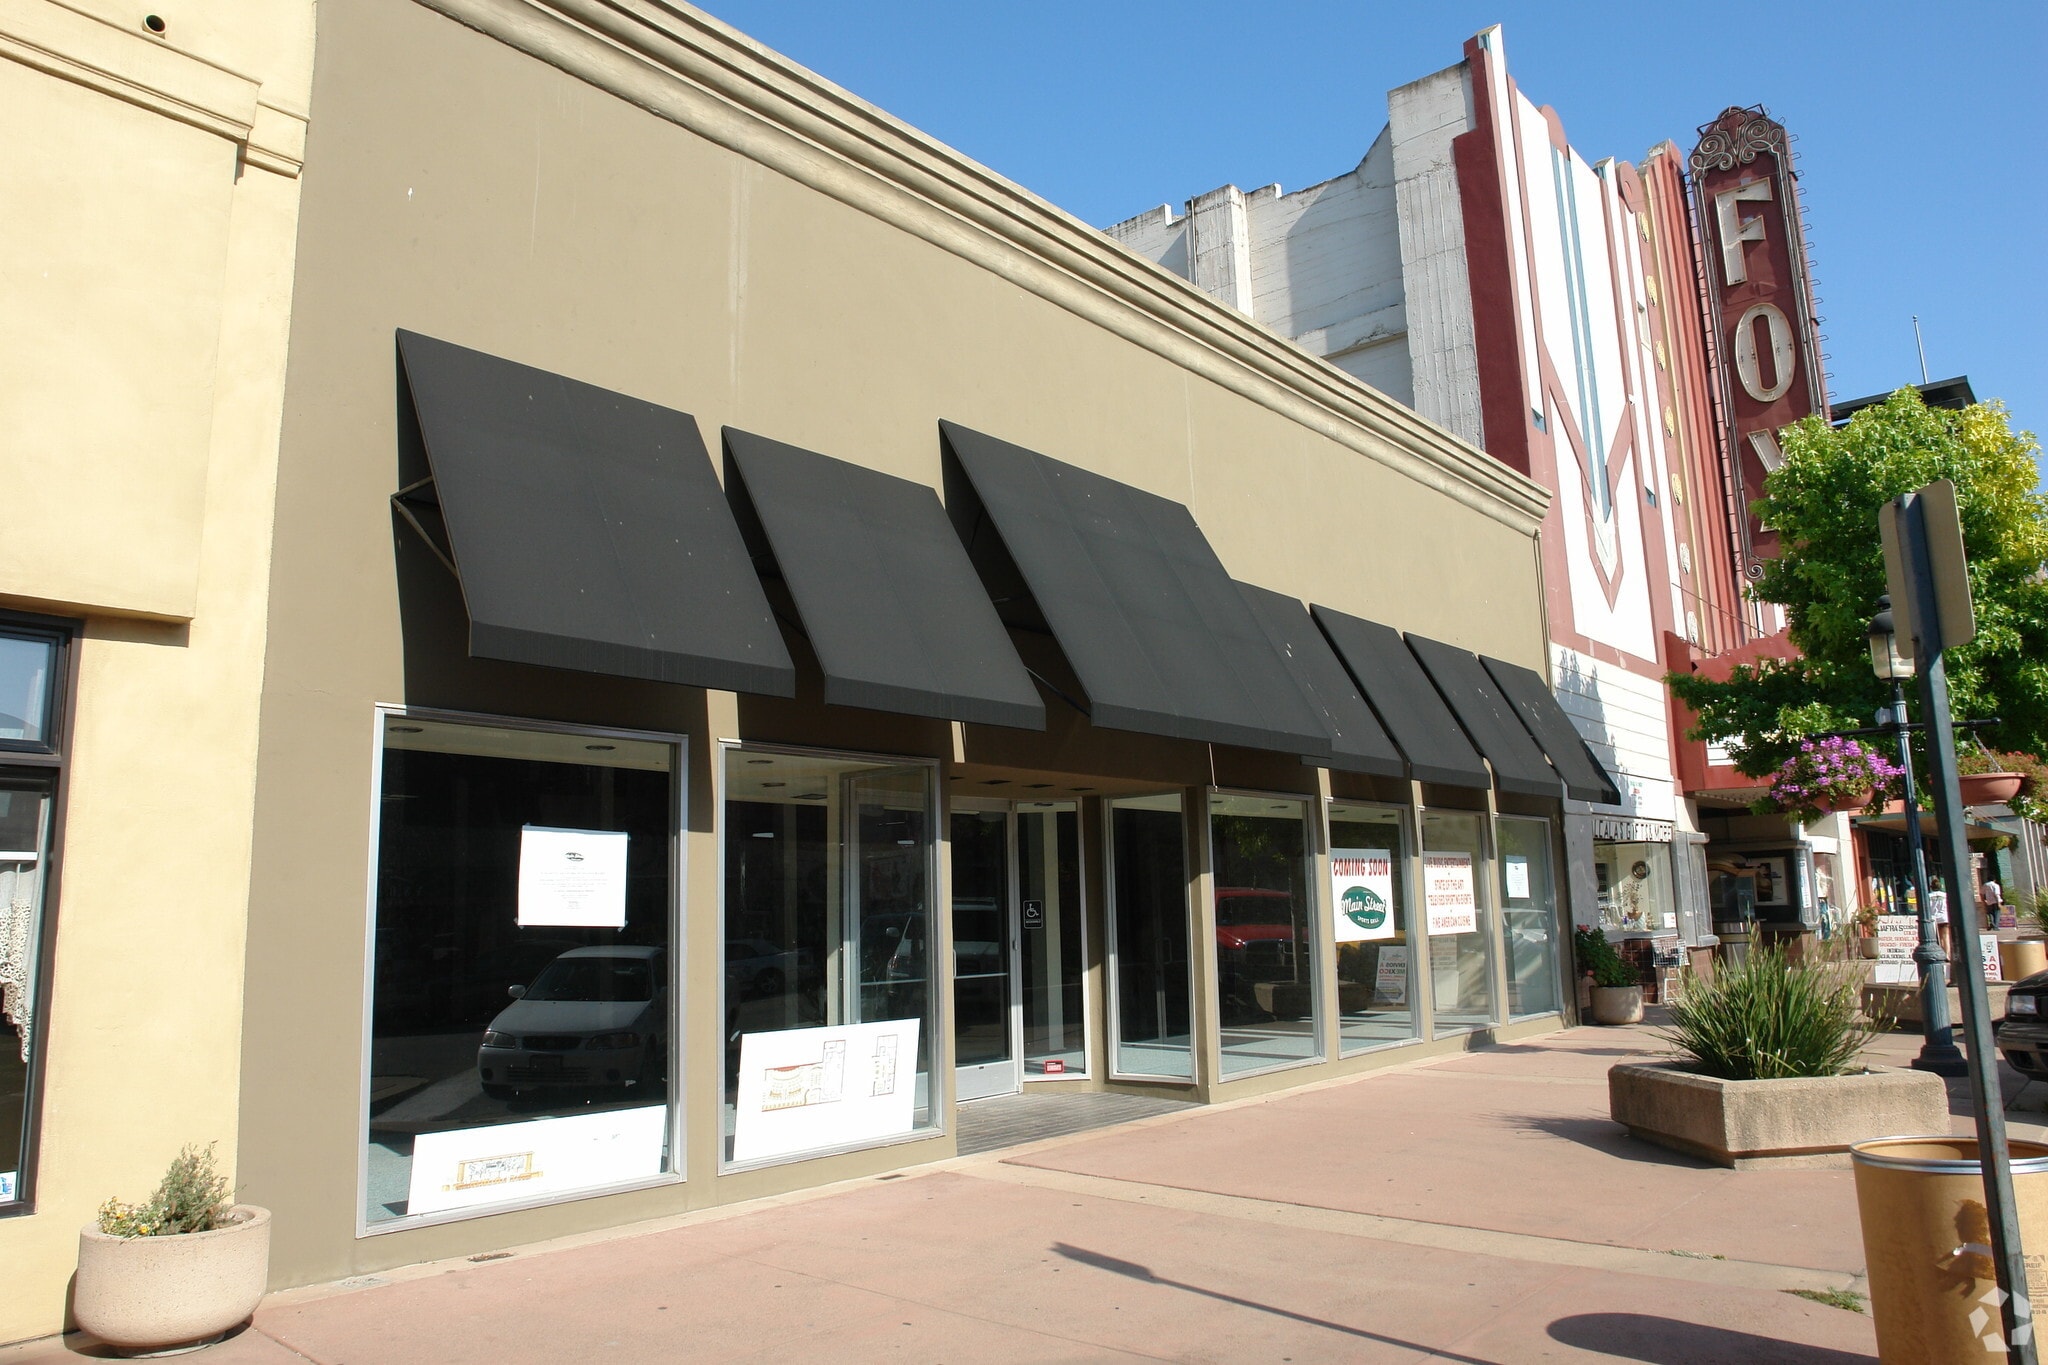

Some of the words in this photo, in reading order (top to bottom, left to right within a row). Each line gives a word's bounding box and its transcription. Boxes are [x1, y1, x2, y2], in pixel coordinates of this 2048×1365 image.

[1334, 858, 1365, 876] COMING
[1369, 858, 1388, 876] SOON
[1341, 896, 1363, 916] Main
[1364, 896, 1386, 913] Street
